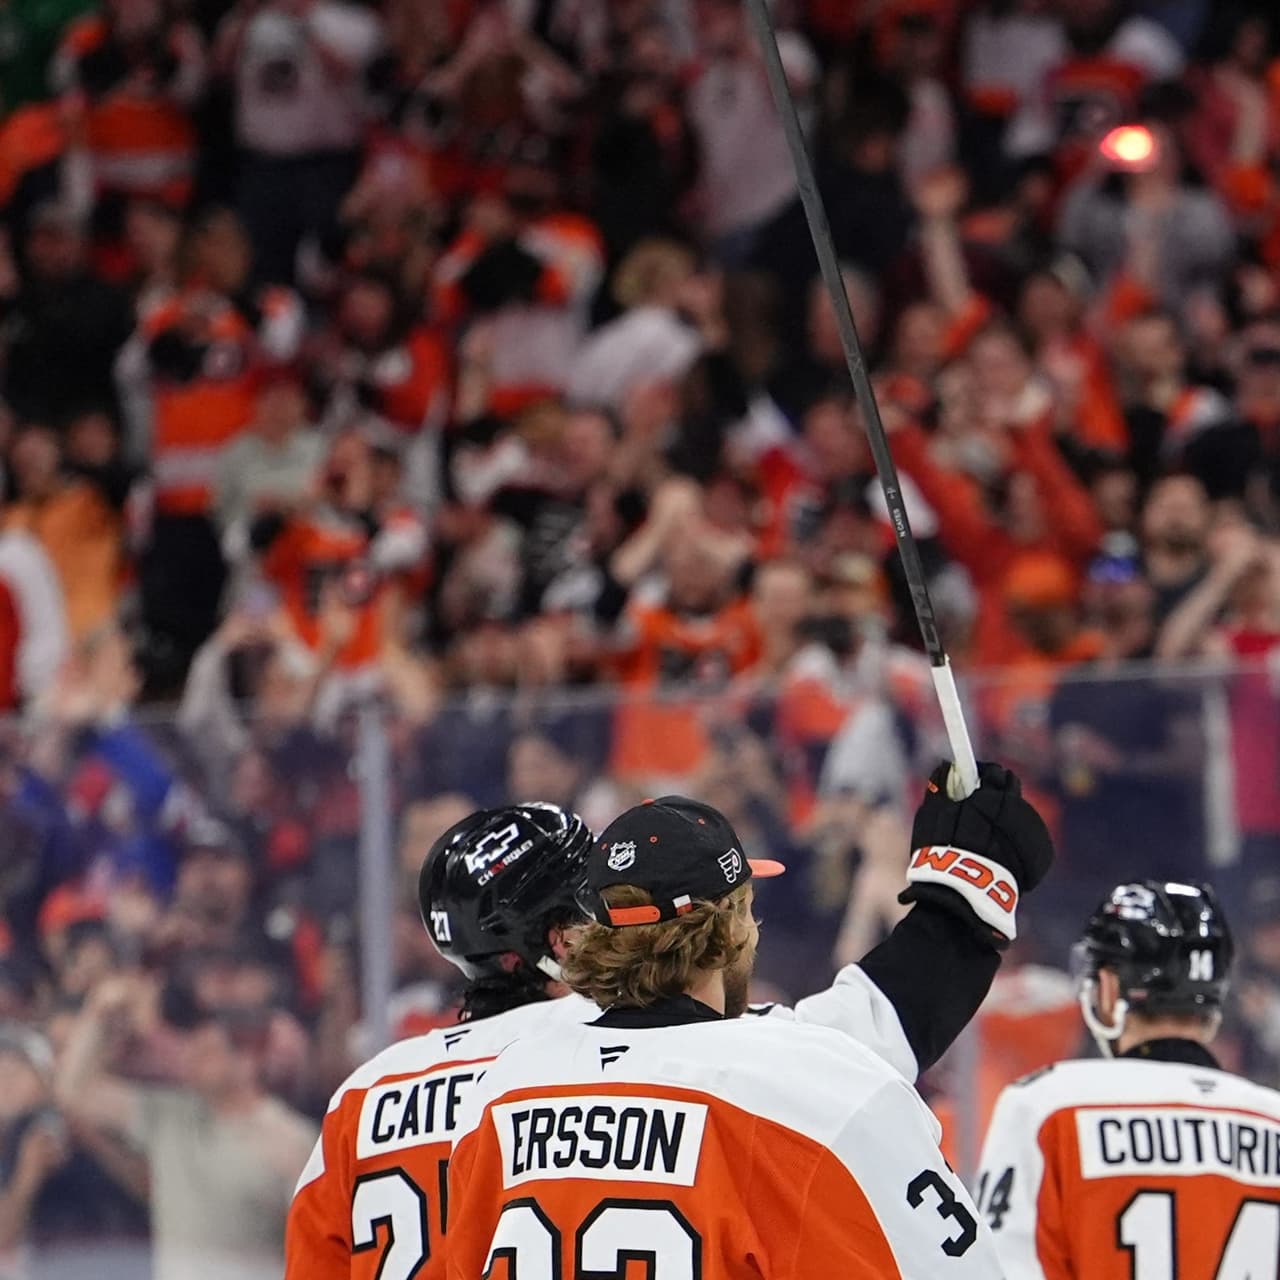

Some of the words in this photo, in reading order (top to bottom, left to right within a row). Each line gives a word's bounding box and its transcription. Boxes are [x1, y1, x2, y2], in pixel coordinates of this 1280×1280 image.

[912, 846, 1018, 914] CCM
[430, 911, 451, 942] 27
[1188, 950, 1214, 980] 14
[371, 1070, 486, 1145] CATE
[512, 1106, 685, 1175] ERSSON
